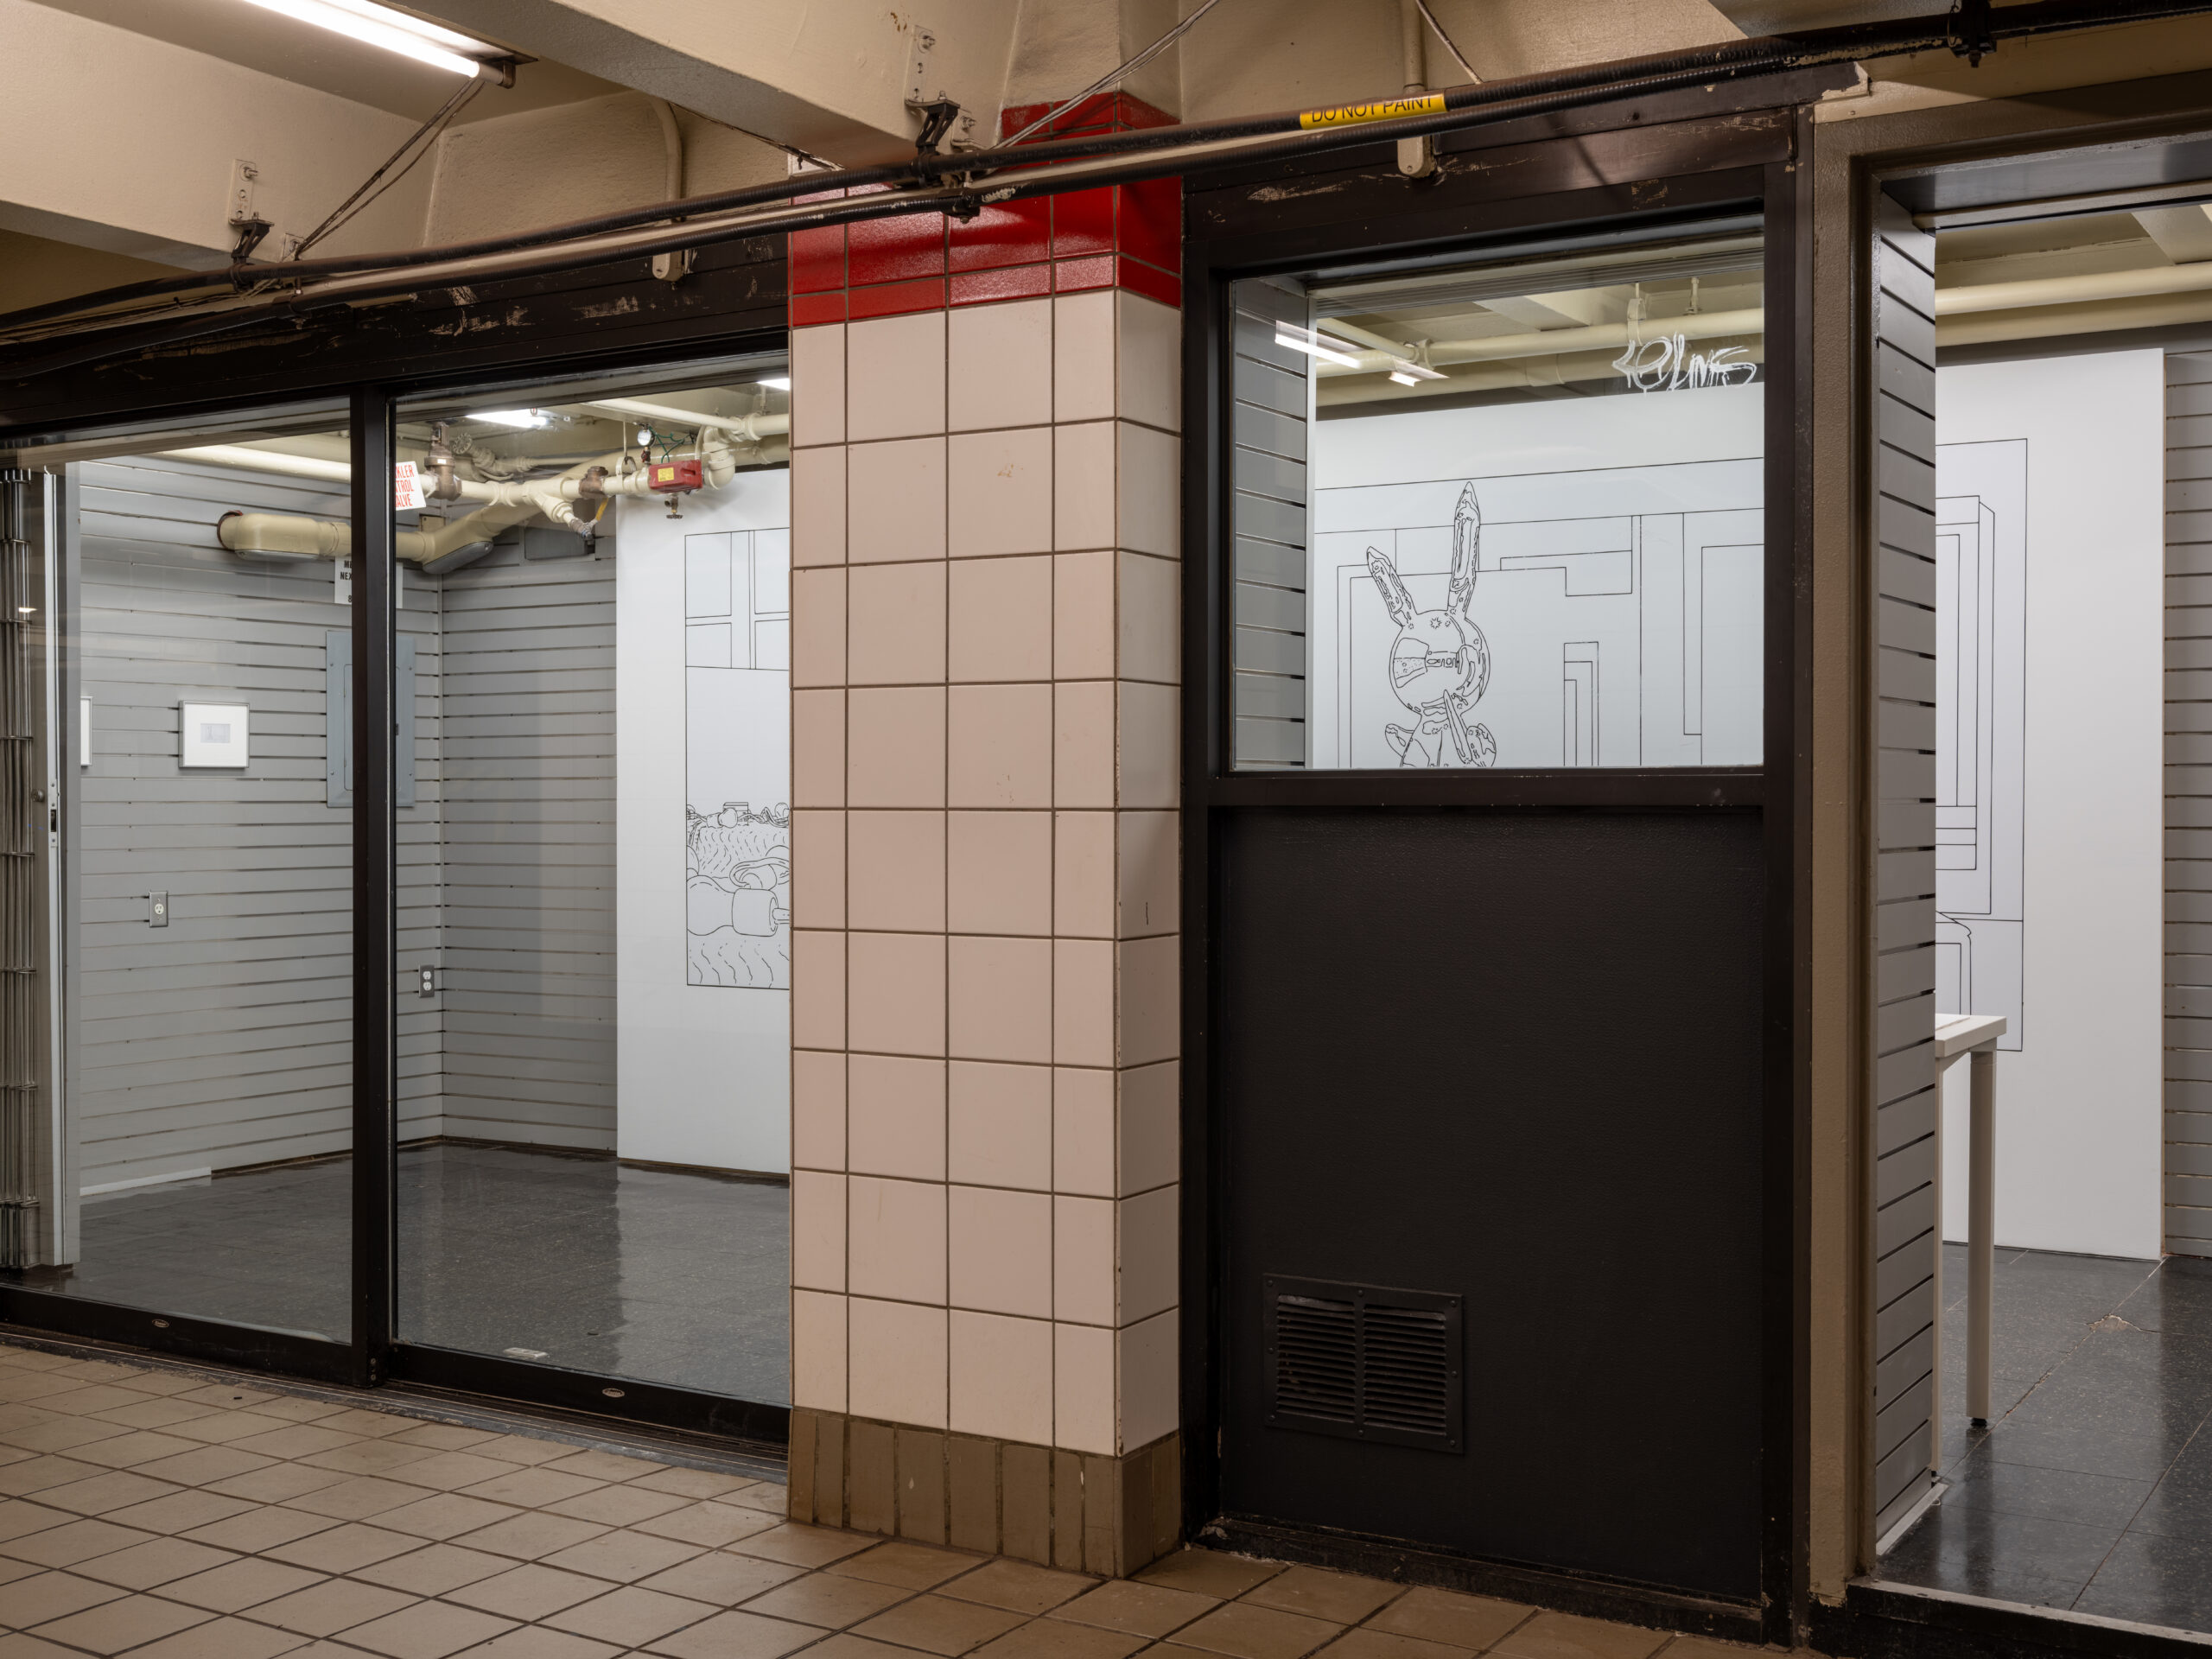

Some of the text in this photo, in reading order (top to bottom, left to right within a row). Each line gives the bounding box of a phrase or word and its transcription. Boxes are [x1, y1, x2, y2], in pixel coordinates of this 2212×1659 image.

[1311, 96, 1434, 123] DO NOT PAINT
[395, 493, 413, 508] ALVE
[340, 571, 353, 581] NEX
